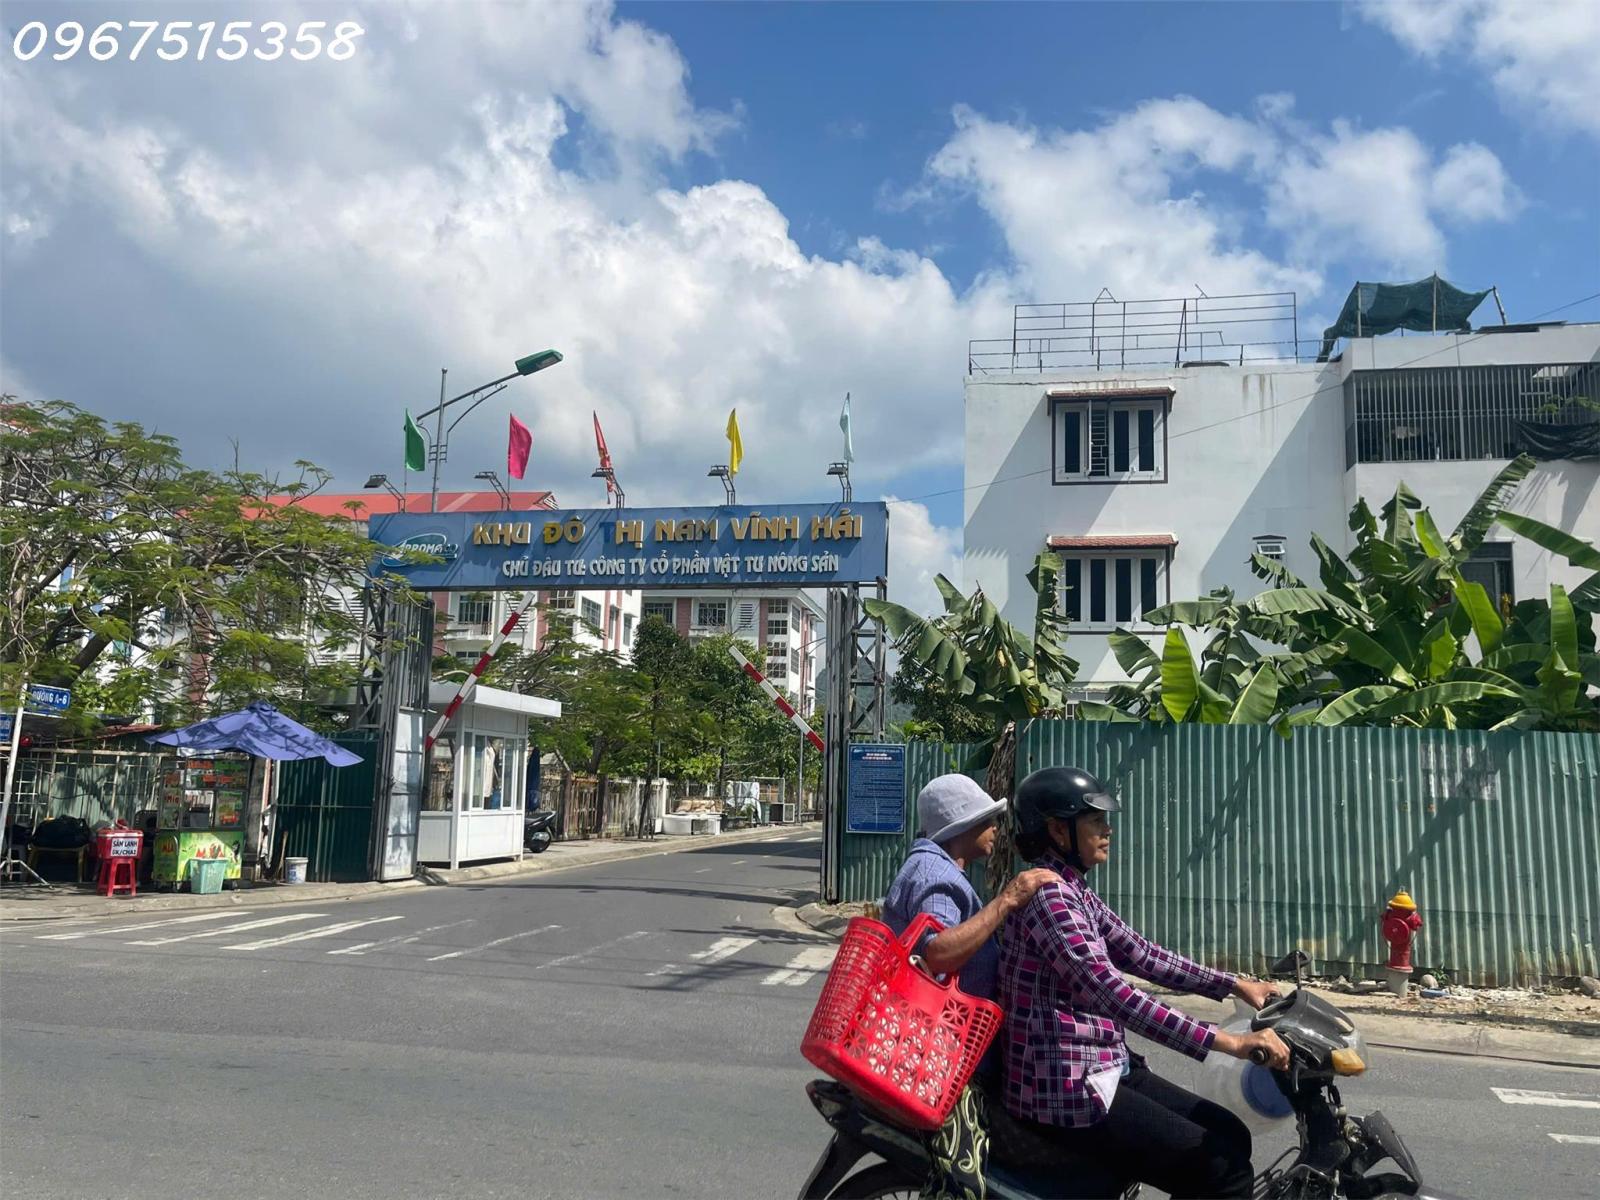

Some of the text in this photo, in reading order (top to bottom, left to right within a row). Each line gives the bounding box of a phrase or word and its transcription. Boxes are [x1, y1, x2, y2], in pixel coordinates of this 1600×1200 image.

[473, 522, 532, 546] KHU
[543, 515, 587, 544] ĐÔ
[655, 519, 719, 542] NAM
[731, 511, 799, 542] VĨNH
[589, 555, 625, 576] CÔNG
[629, 558, 647, 576] TY
[650, 550, 668, 575] CỔ
[671, 550, 710, 575] PHẦN
[713, 553, 740, 577] VẬT
[767, 551, 807, 573] NÔNG
[811, 550, 838, 573] SẢN
